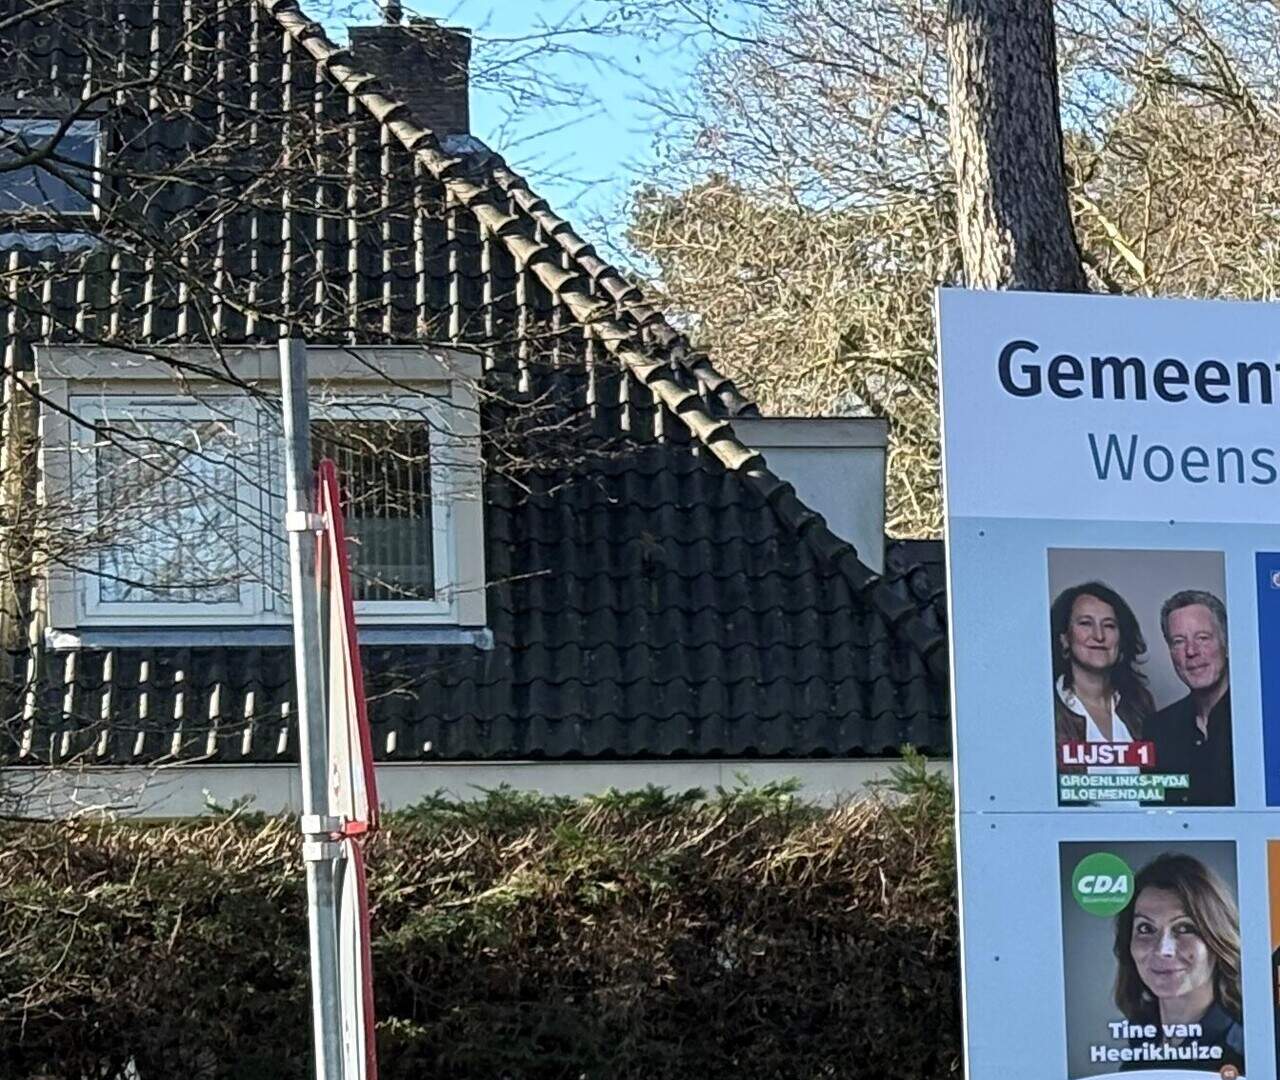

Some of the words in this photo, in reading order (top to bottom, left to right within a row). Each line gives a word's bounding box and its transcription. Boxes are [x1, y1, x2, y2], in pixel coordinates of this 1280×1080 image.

[1062, 744, 1129, 765] LIJST
[1137, 745, 1150, 765] 1
[1060, 788, 1165, 801] BLOEMENDAAL
[1077, 874, 1129, 894] CDA
[1108, 1019, 1158, 1039] Tine
[1161, 1022, 1203, 1038] van
[1090, 1041, 1223, 1063] Heerikhuize
